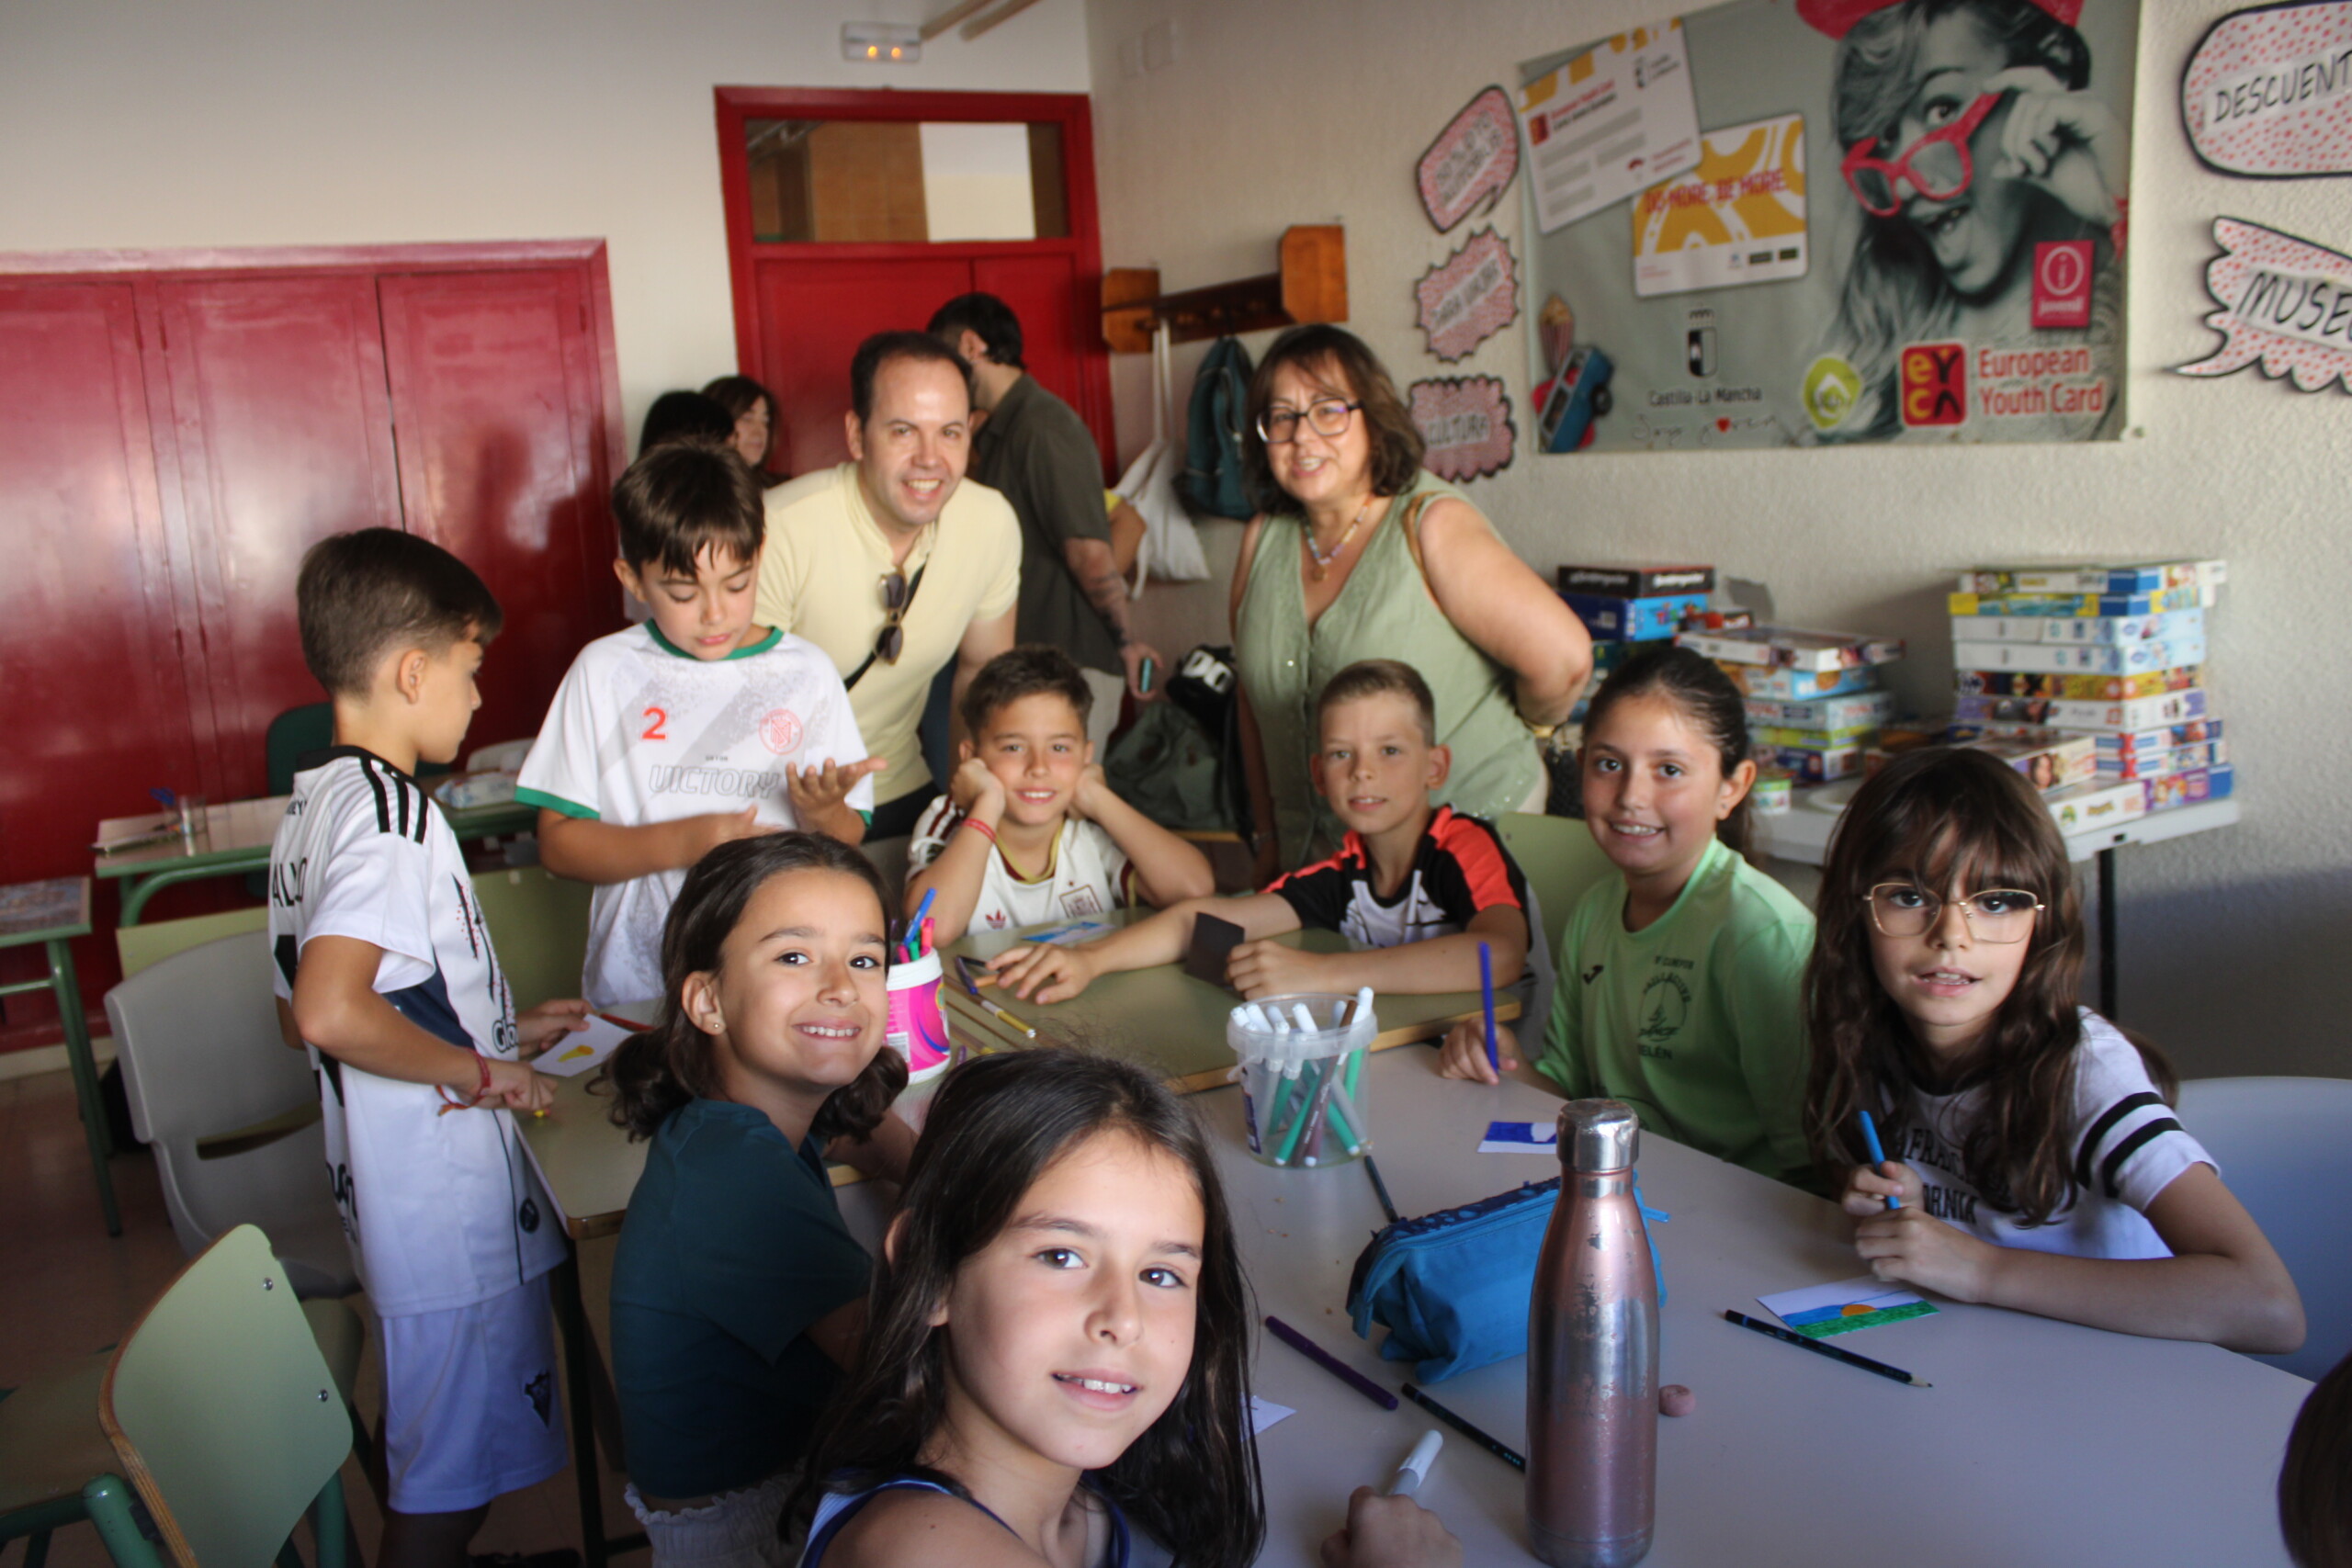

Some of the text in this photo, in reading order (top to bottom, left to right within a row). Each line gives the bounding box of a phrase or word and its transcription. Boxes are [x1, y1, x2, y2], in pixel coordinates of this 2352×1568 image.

[2236, 272, 2352, 341] MUSE
[1979, 348, 2090, 378] European
[1979, 381, 2104, 415] Youth Card
[641, 706, 666, 739] 2
